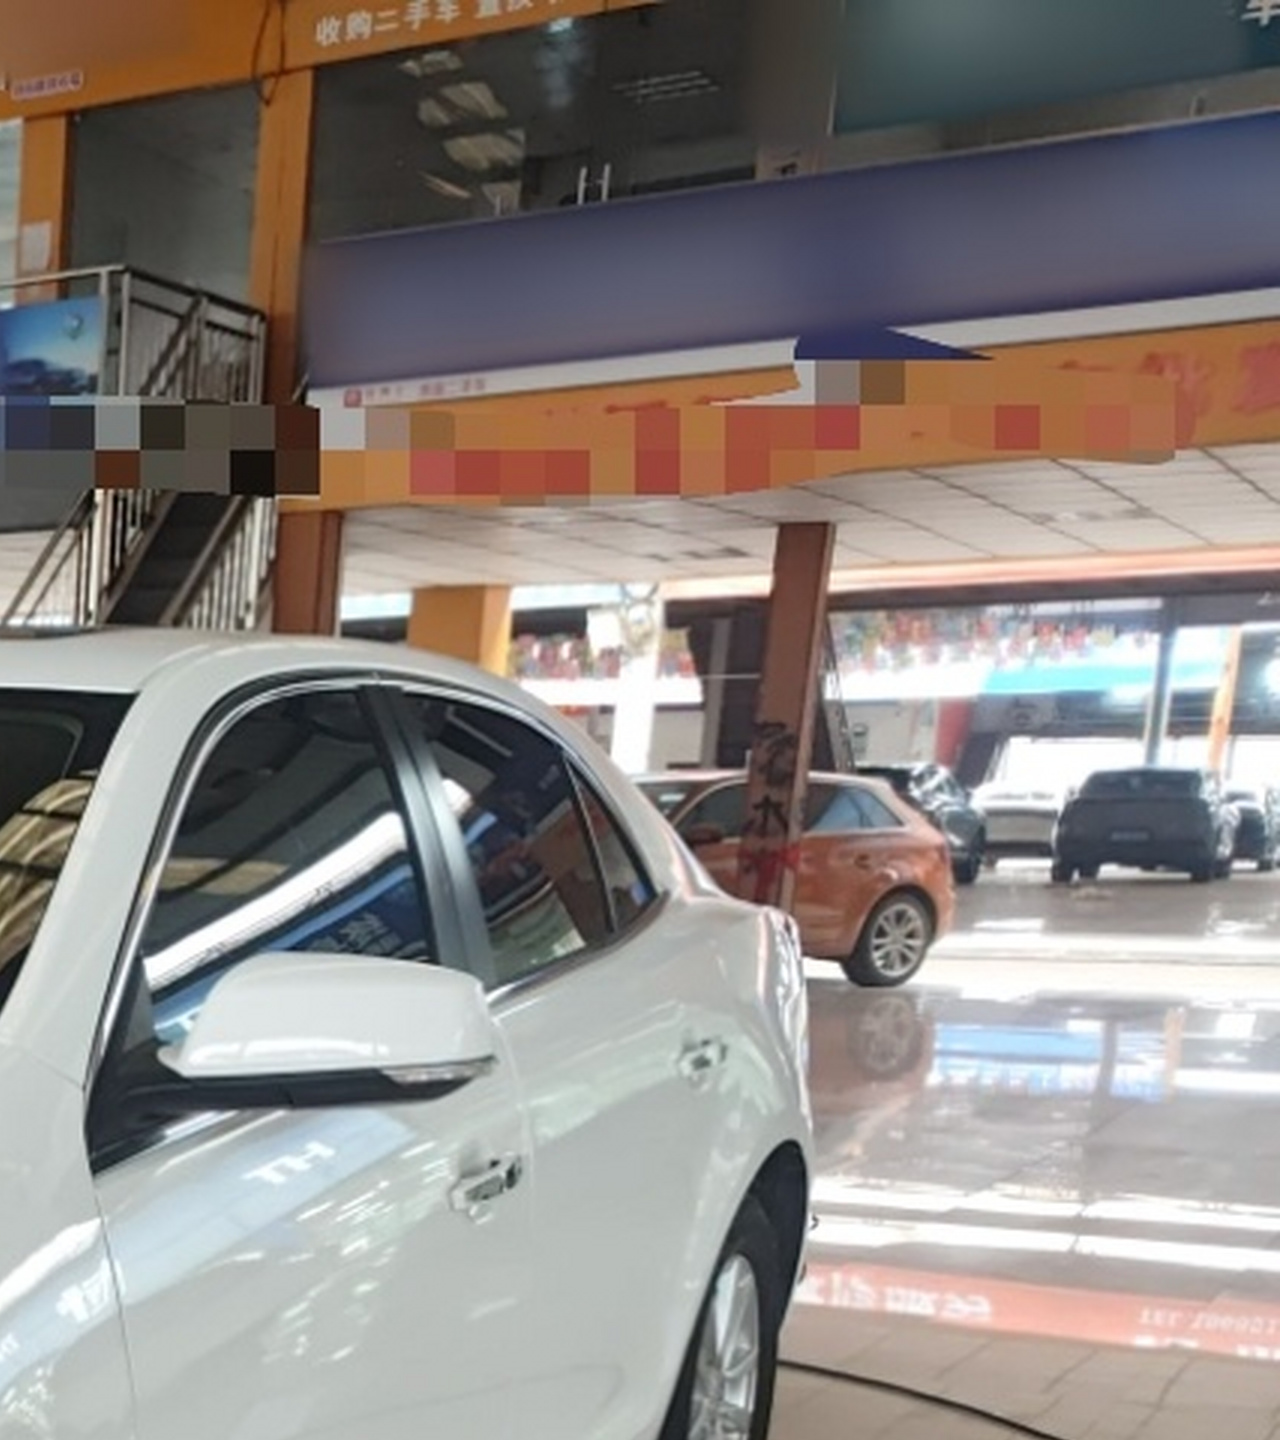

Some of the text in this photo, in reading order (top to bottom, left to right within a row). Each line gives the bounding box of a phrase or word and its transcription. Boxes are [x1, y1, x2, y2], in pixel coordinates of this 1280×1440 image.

[314, 0, 462, 46] 收购二手车
